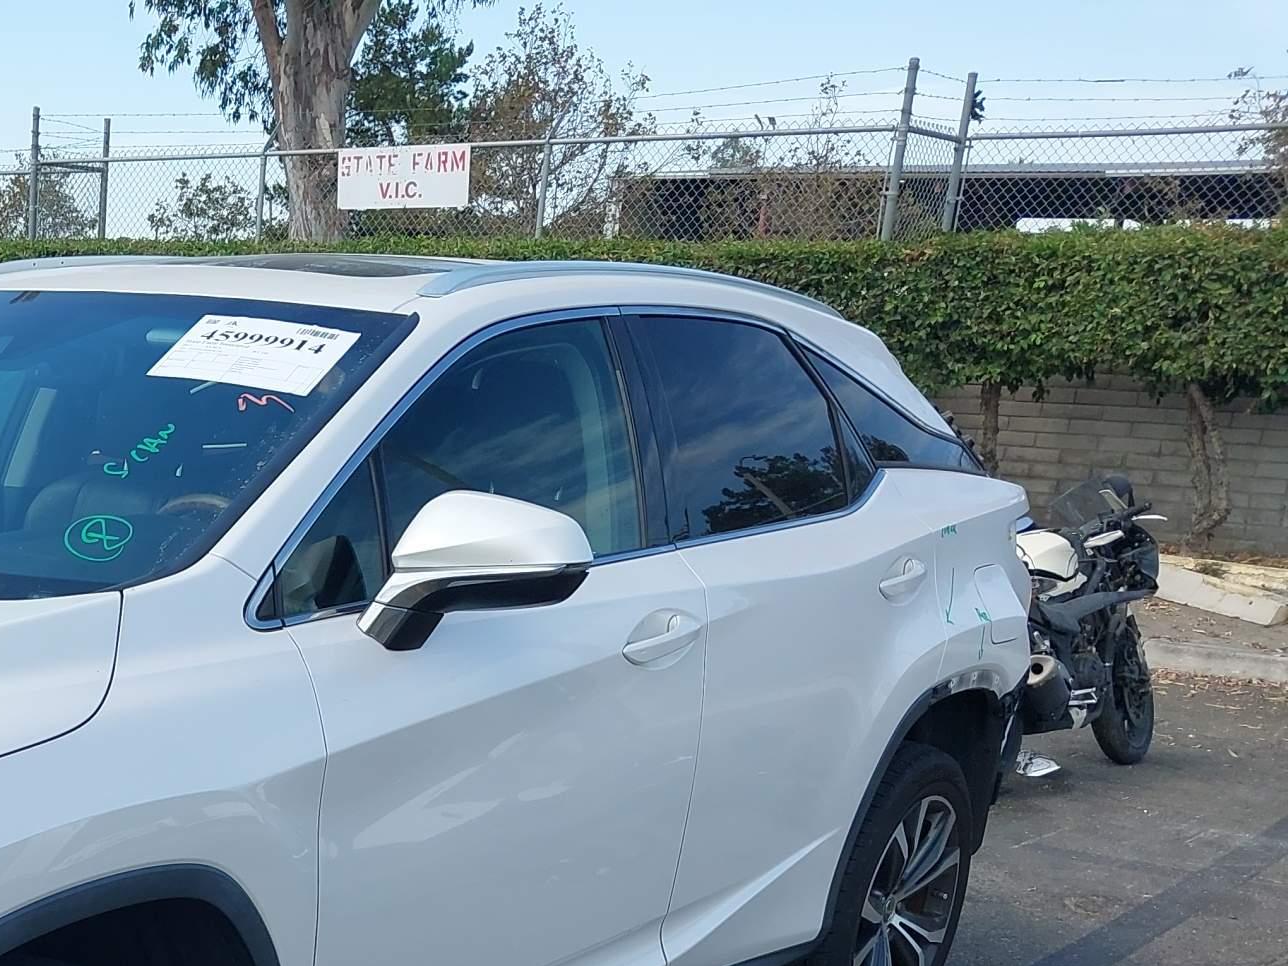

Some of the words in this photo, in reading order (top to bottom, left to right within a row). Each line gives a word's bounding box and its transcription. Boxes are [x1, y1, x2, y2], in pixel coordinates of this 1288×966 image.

[340, 153, 399, 177] STATE
[412, 150, 467, 175] FARM
[378, 180, 423, 200] V.I.C.
[200, 329, 327, 355] 45999914
